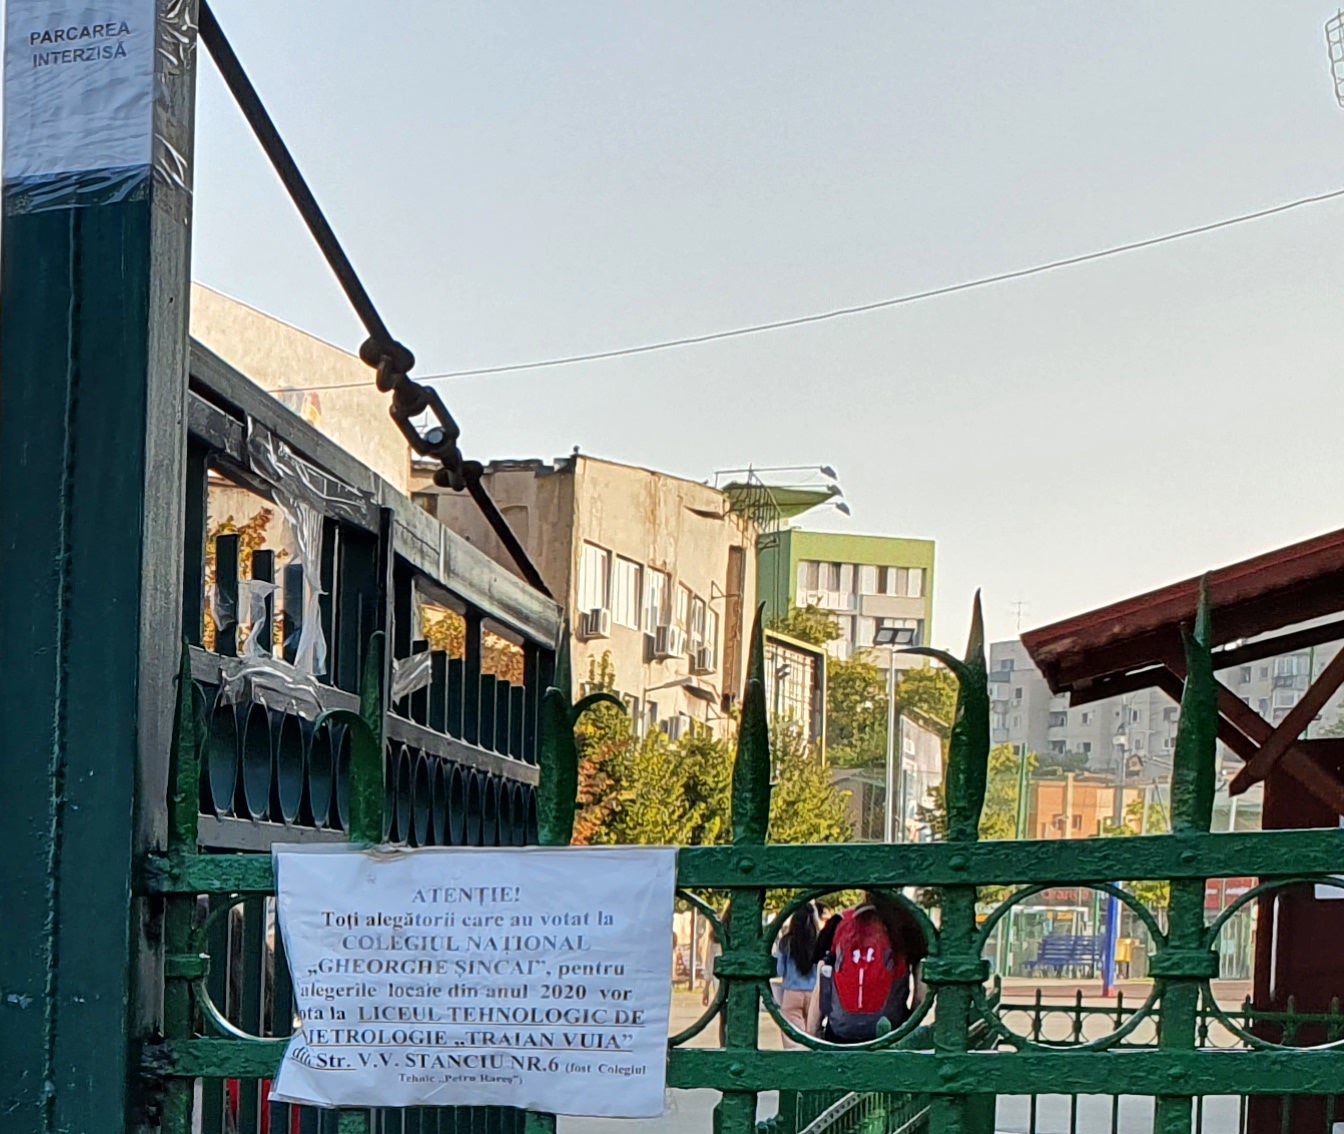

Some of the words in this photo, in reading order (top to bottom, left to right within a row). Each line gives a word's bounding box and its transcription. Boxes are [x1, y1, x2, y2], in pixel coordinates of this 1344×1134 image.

[30, 21, 130, 45] PARCAREA
[33, 41, 127, 67] INTERZISĂ
[412, 886, 520, 906] ATENȚIE!
[322, 911, 359, 930] Toți
[366, 911, 455, 929] alegătorii
[462, 915, 504, 927] care
[510, 914, 533, 927] au
[540, 912, 589, 926] votat
[598, 910, 614, 926] la
[342, 934, 459, 951] COLEGIUL
[467, 934, 591, 955] NAȚIONAL
[558, 961, 625, 979] pentru
[300, 983, 377, 1000] alegerile
[389, 983, 442, 998] locale
[448, 983, 478, 998] din
[485, 984, 528, 999] anul
[540, 984, 587, 999] 2020
[600, 988, 633, 1001] vor
[330, 1006, 346, 1021] la
[358, 1005, 441, 1022] LICEUL
[447, 1006, 608, 1024] TEHNOLOGIC
[615, 1009, 645, 1025] DE
[316, 1052, 351, 1068] Str.
[358, 1052, 399, 1069] V.V.
[406, 1053, 504, 1070] STANCIU
[565, 1062, 591, 1074] (fost
[598, 1063, 647, 1076] Colegiul
[399, 1073, 435, 1083] Tehnic
